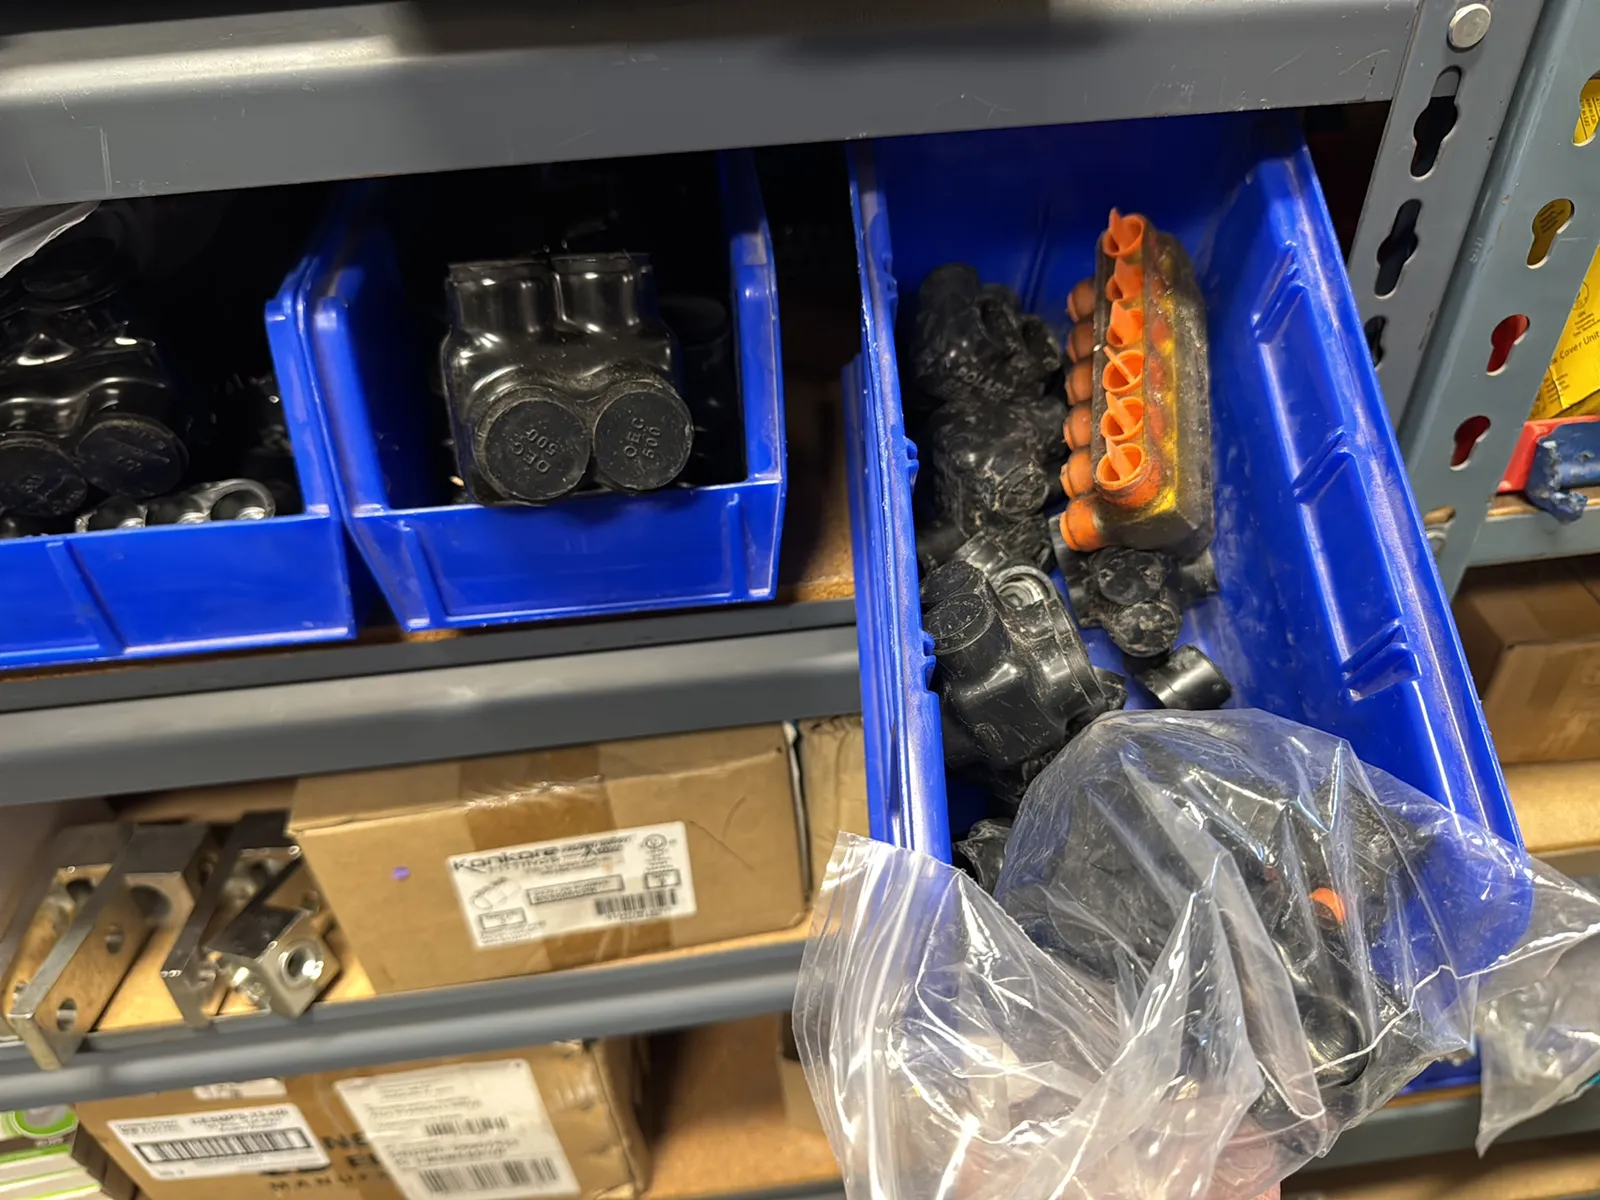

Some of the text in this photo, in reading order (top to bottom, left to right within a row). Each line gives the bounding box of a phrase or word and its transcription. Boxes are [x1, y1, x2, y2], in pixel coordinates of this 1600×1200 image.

[1559, 330, 1600, 360] Cover Unit
[527, 428, 558, 456] 500
[642, 426, 661, 459] 500
